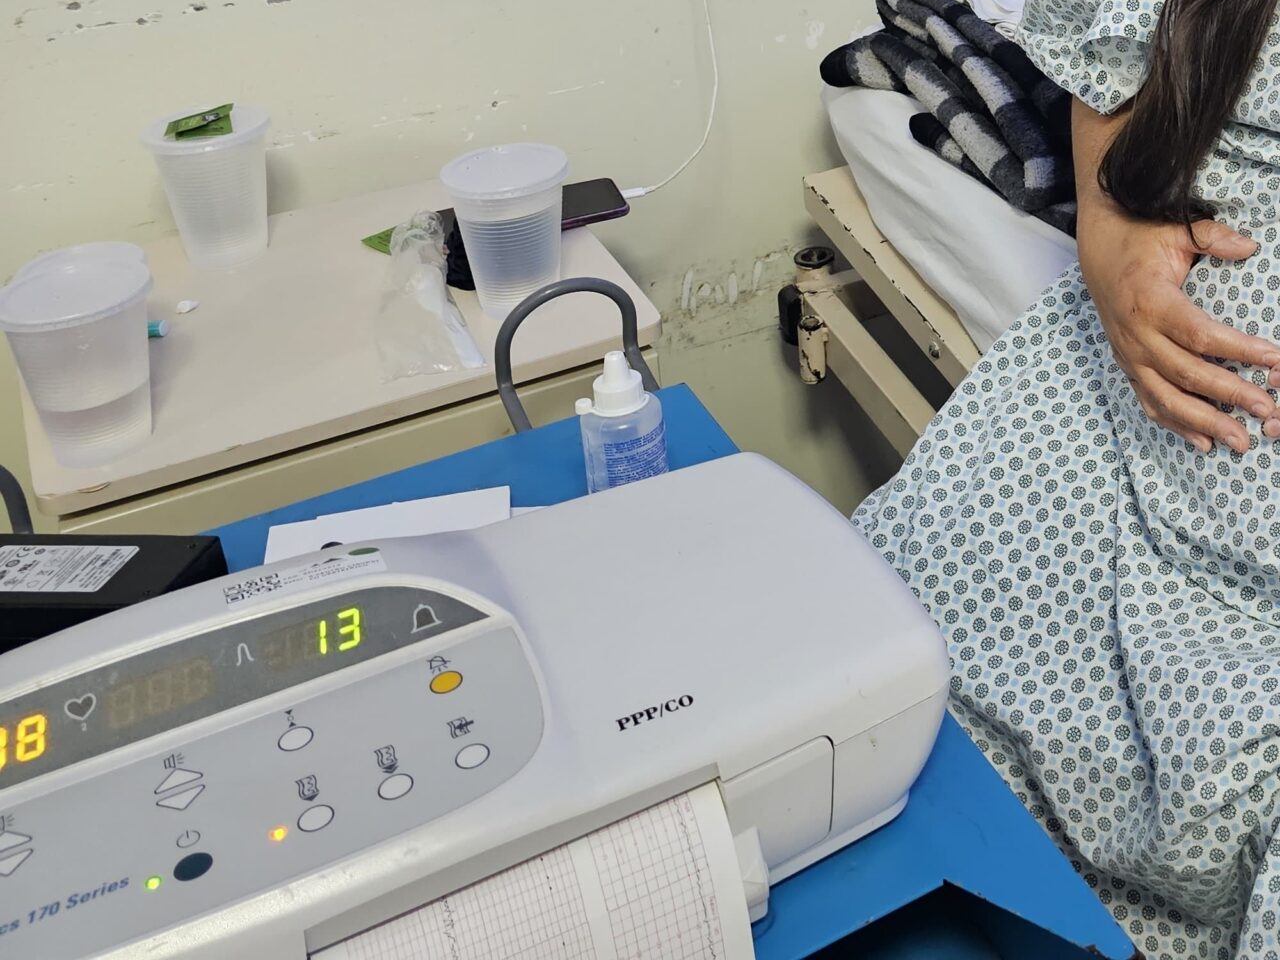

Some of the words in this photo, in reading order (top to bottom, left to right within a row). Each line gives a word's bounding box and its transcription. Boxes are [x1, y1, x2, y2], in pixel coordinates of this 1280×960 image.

[319, 607, 361, 655] 13
[615, 694, 694, 732] PPP/CO
[27, 901, 61, 924] 170
[65, 876, 130, 910] Series
